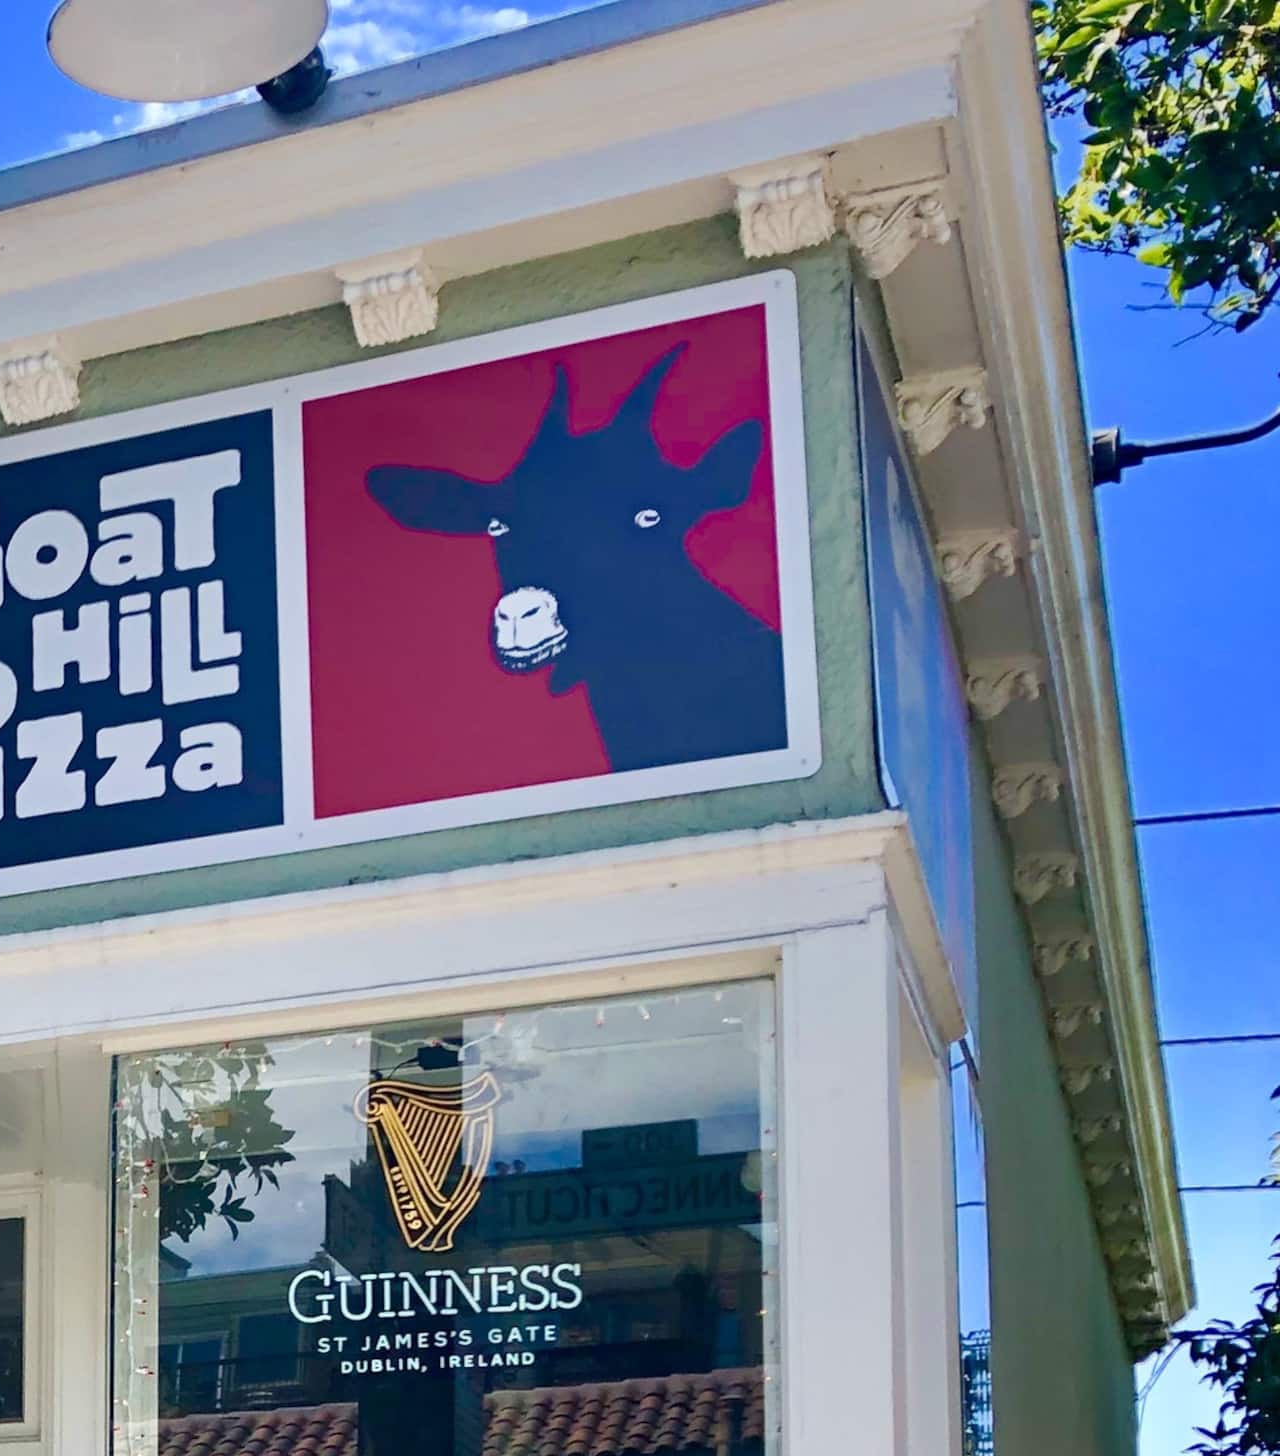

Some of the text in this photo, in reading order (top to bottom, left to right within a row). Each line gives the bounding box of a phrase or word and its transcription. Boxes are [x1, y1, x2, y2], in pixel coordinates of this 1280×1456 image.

[397, 1194, 423, 1230] 1759
[287, 1263, 584, 1324] GUINNESS
[317, 1325, 558, 1353] ST JAMES'S GATE
[340, 1352, 536, 1375] DUBLIN, IRELAND
